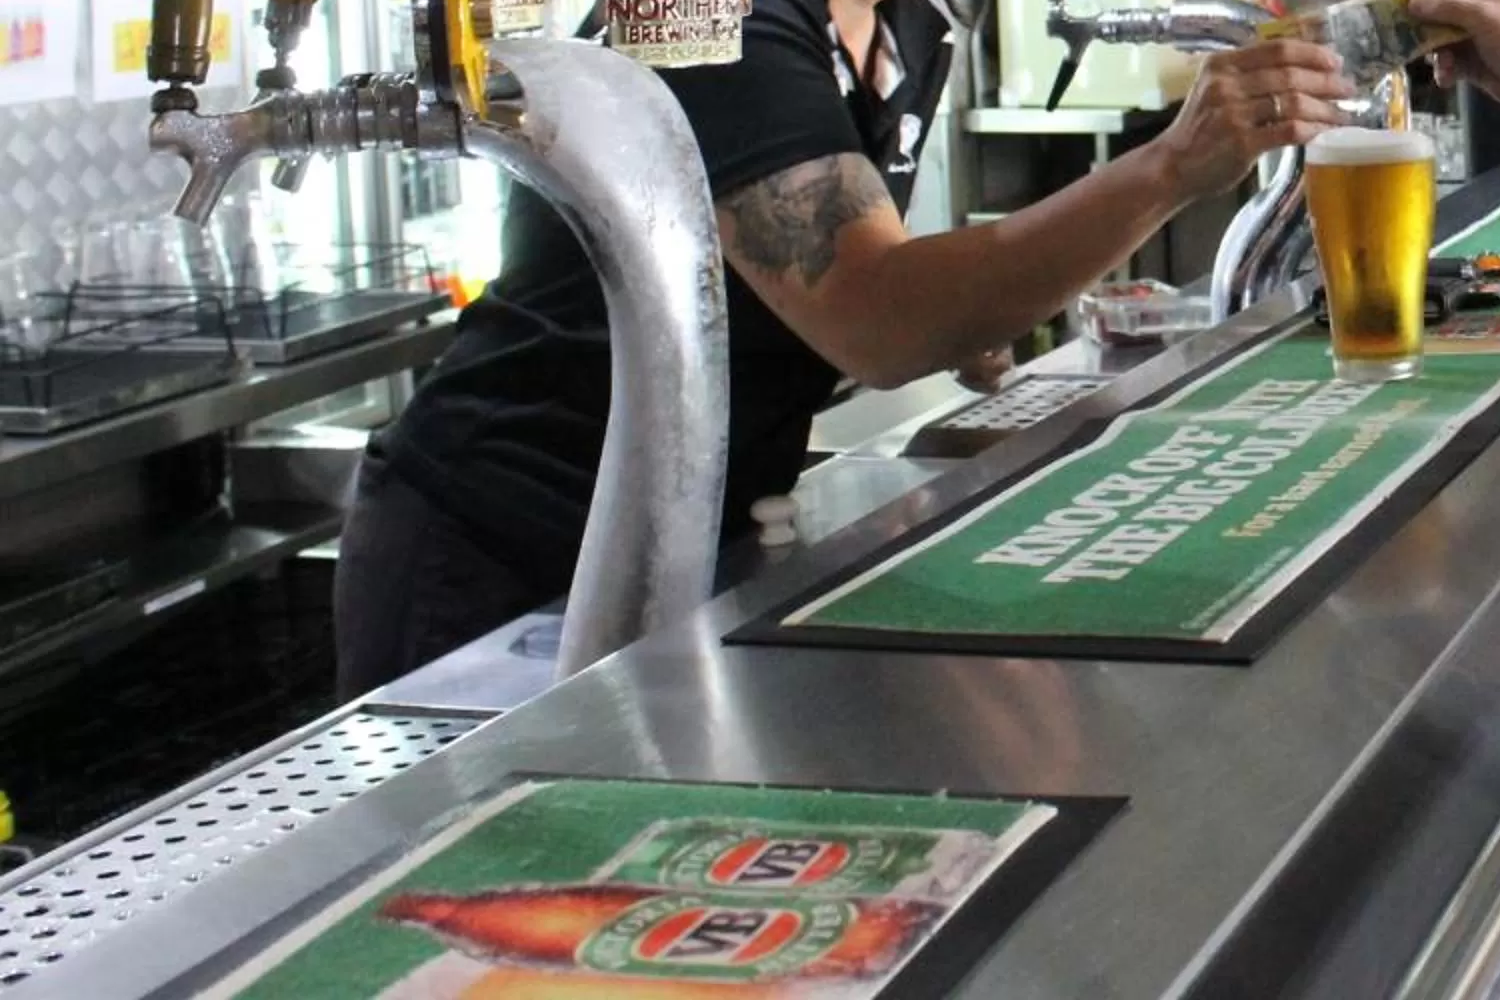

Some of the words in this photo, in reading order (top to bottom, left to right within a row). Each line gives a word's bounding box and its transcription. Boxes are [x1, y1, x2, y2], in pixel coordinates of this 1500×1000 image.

[971, 472, 1176, 567] KNOCK
[1127, 424, 1234, 473] OFF
[1039, 523, 1192, 582] THE
[1132, 479, 1253, 522] BIG
[1203, 414, 1328, 478] COLD
[1289, 377, 1385, 416] BEE
[735, 842, 822, 881] VB
[661, 910, 770, 959] VB
